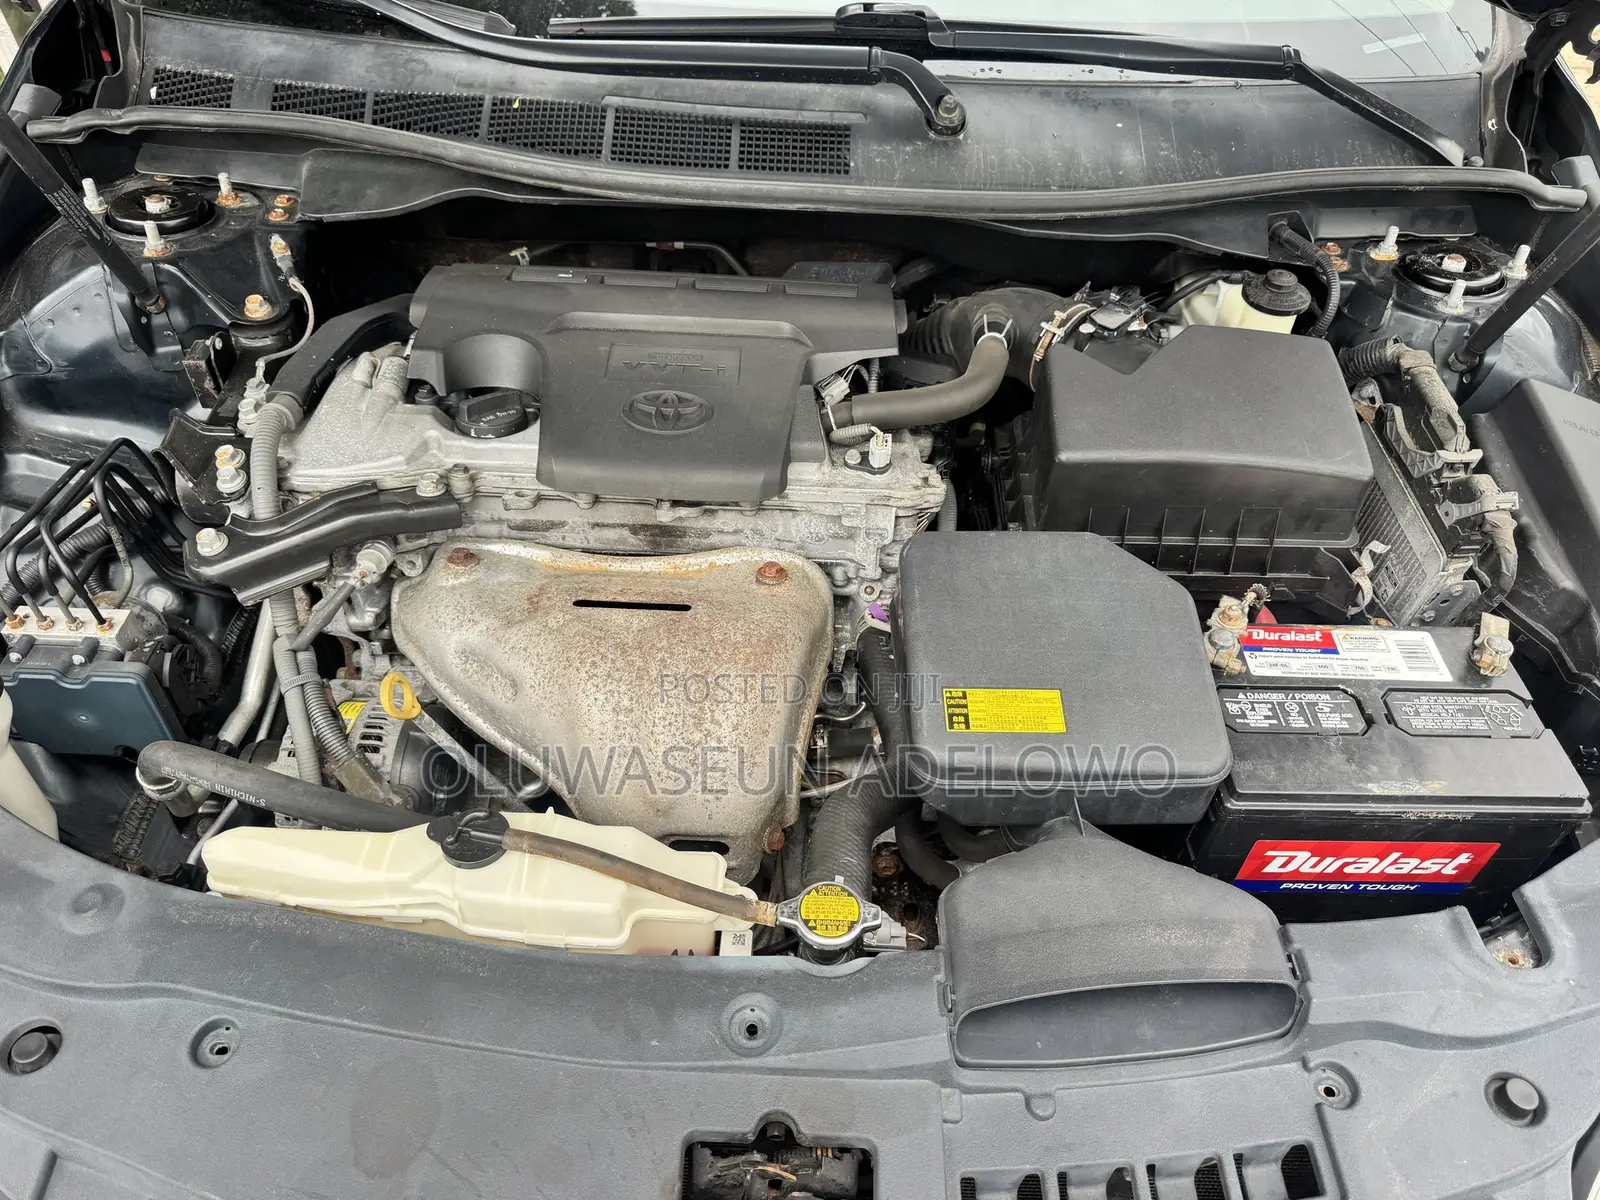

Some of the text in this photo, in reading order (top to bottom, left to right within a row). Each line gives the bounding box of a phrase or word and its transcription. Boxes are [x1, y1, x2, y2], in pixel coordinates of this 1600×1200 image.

[1247, 629, 1323, 642] Duralast
[1247, 692, 1286, 700] DANGER
[1261, 850, 1472, 875] Duralast
[1279, 882, 1418, 891] PROVEN TOUGH
